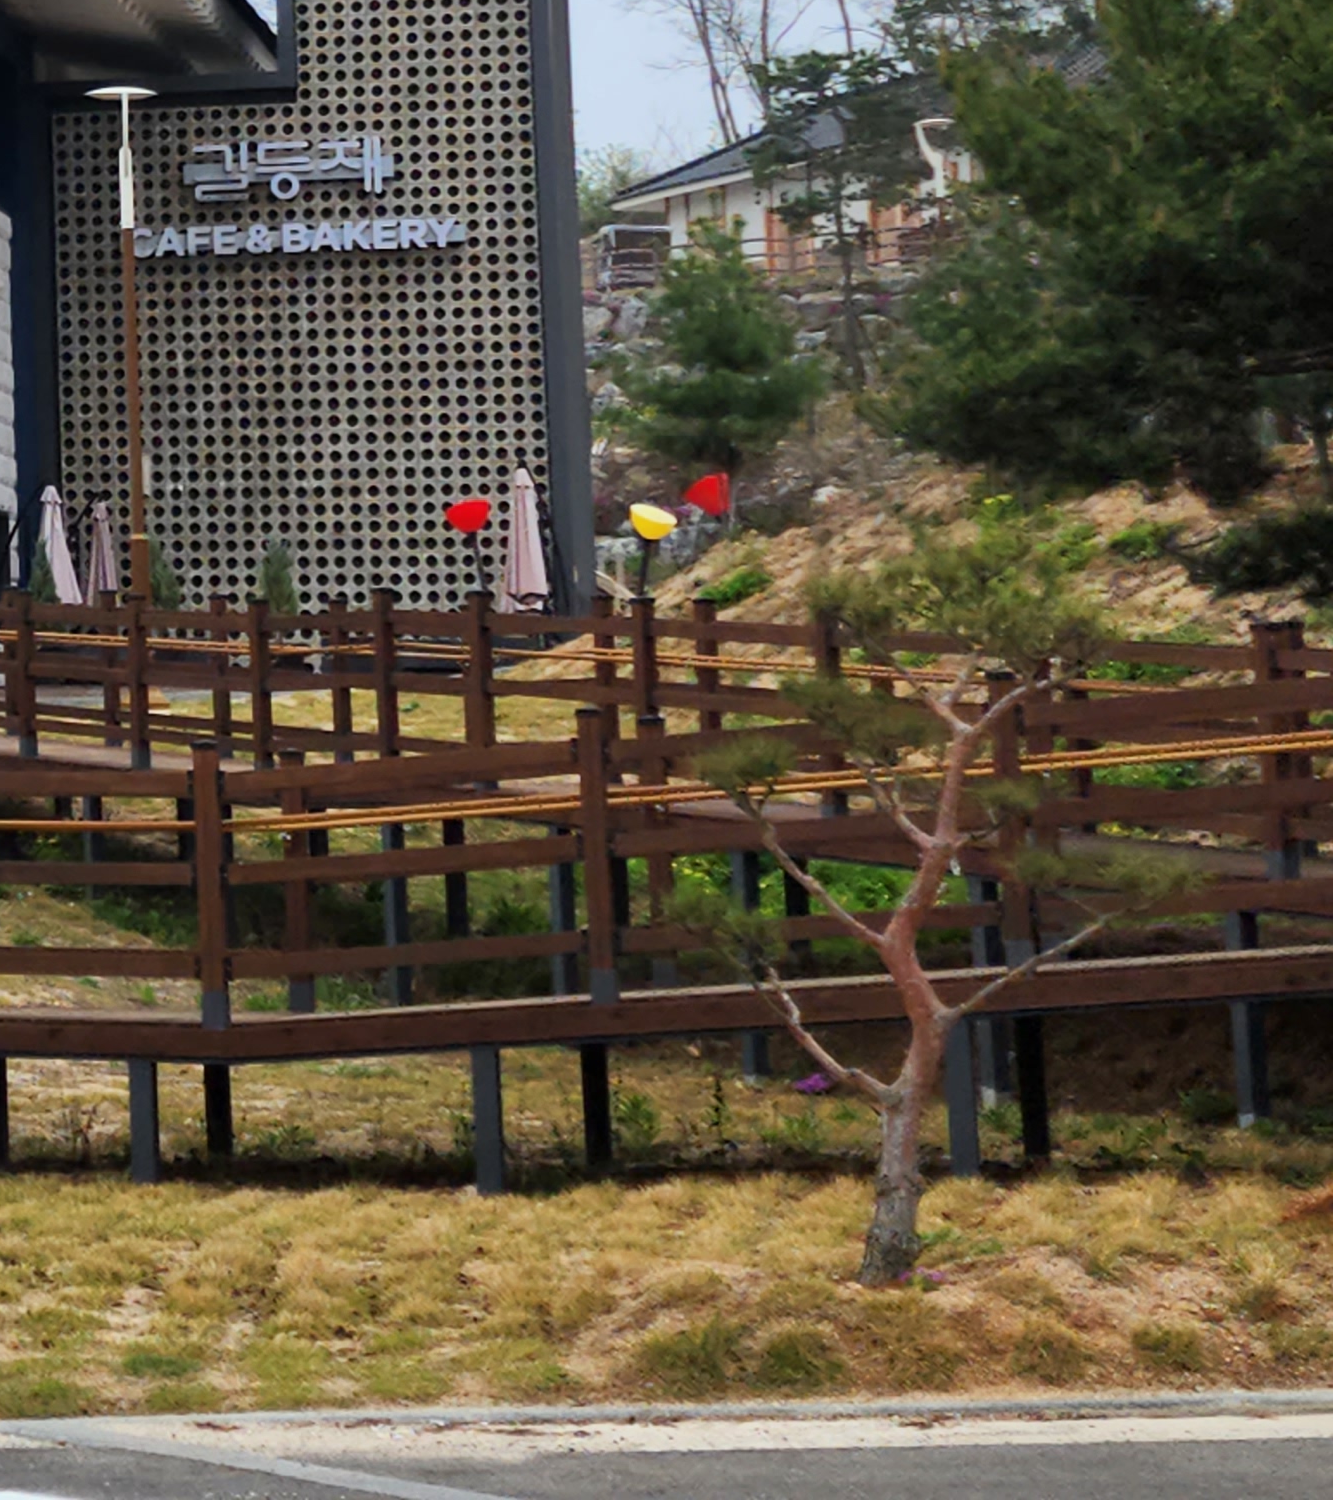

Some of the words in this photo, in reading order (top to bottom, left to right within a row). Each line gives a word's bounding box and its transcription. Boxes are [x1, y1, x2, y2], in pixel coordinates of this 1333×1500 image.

[192, 136, 382, 201] 길등재
[133, 224, 238, 258] CAFE
[246, 224, 273, 254] &
[281, 217, 457, 253] BAKERY
